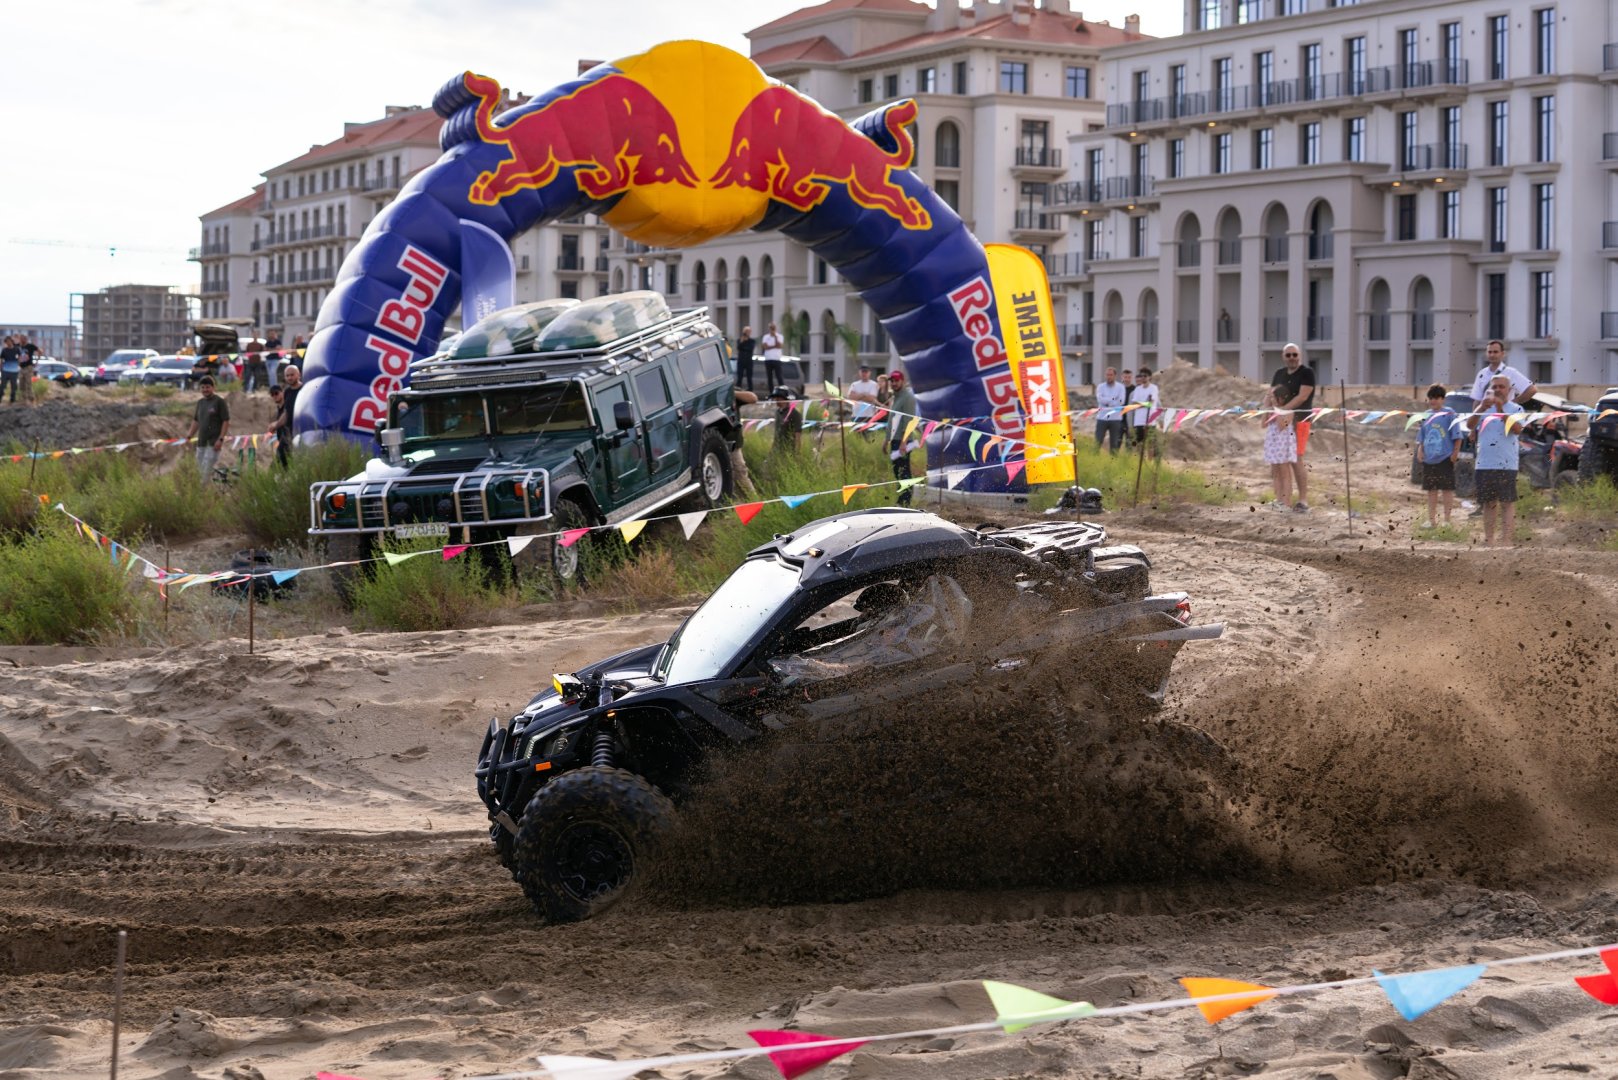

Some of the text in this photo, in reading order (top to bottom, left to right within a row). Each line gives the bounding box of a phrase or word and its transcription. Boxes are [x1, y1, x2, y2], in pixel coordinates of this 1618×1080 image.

[349, 244, 450, 434] Red Bull
[946, 276, 1026, 456] Red Bull
